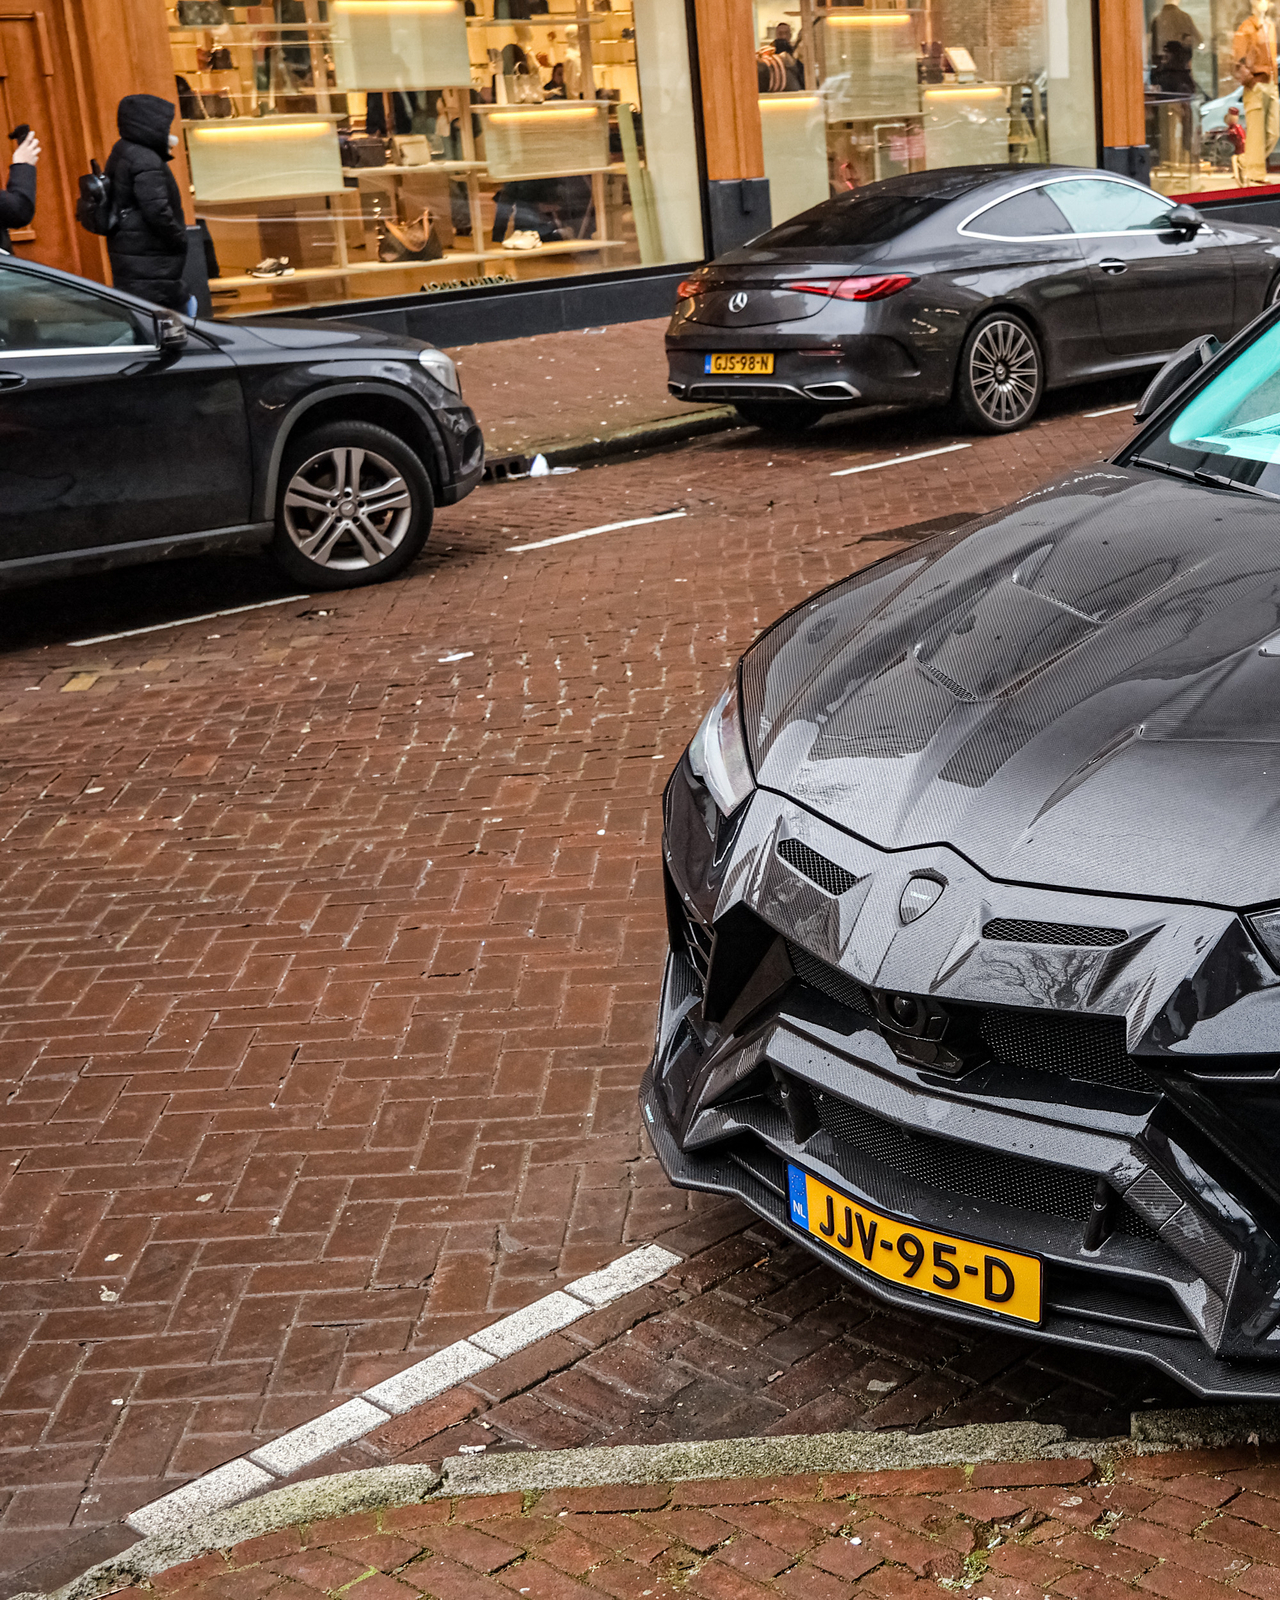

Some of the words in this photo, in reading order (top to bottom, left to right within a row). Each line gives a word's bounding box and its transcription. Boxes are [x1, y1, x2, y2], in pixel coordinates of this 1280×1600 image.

[714, 355, 769, 371] GJS-98-N
[792, 1199, 807, 1219] NL
[819, 1195, 1016, 1303] JJV-95-D
